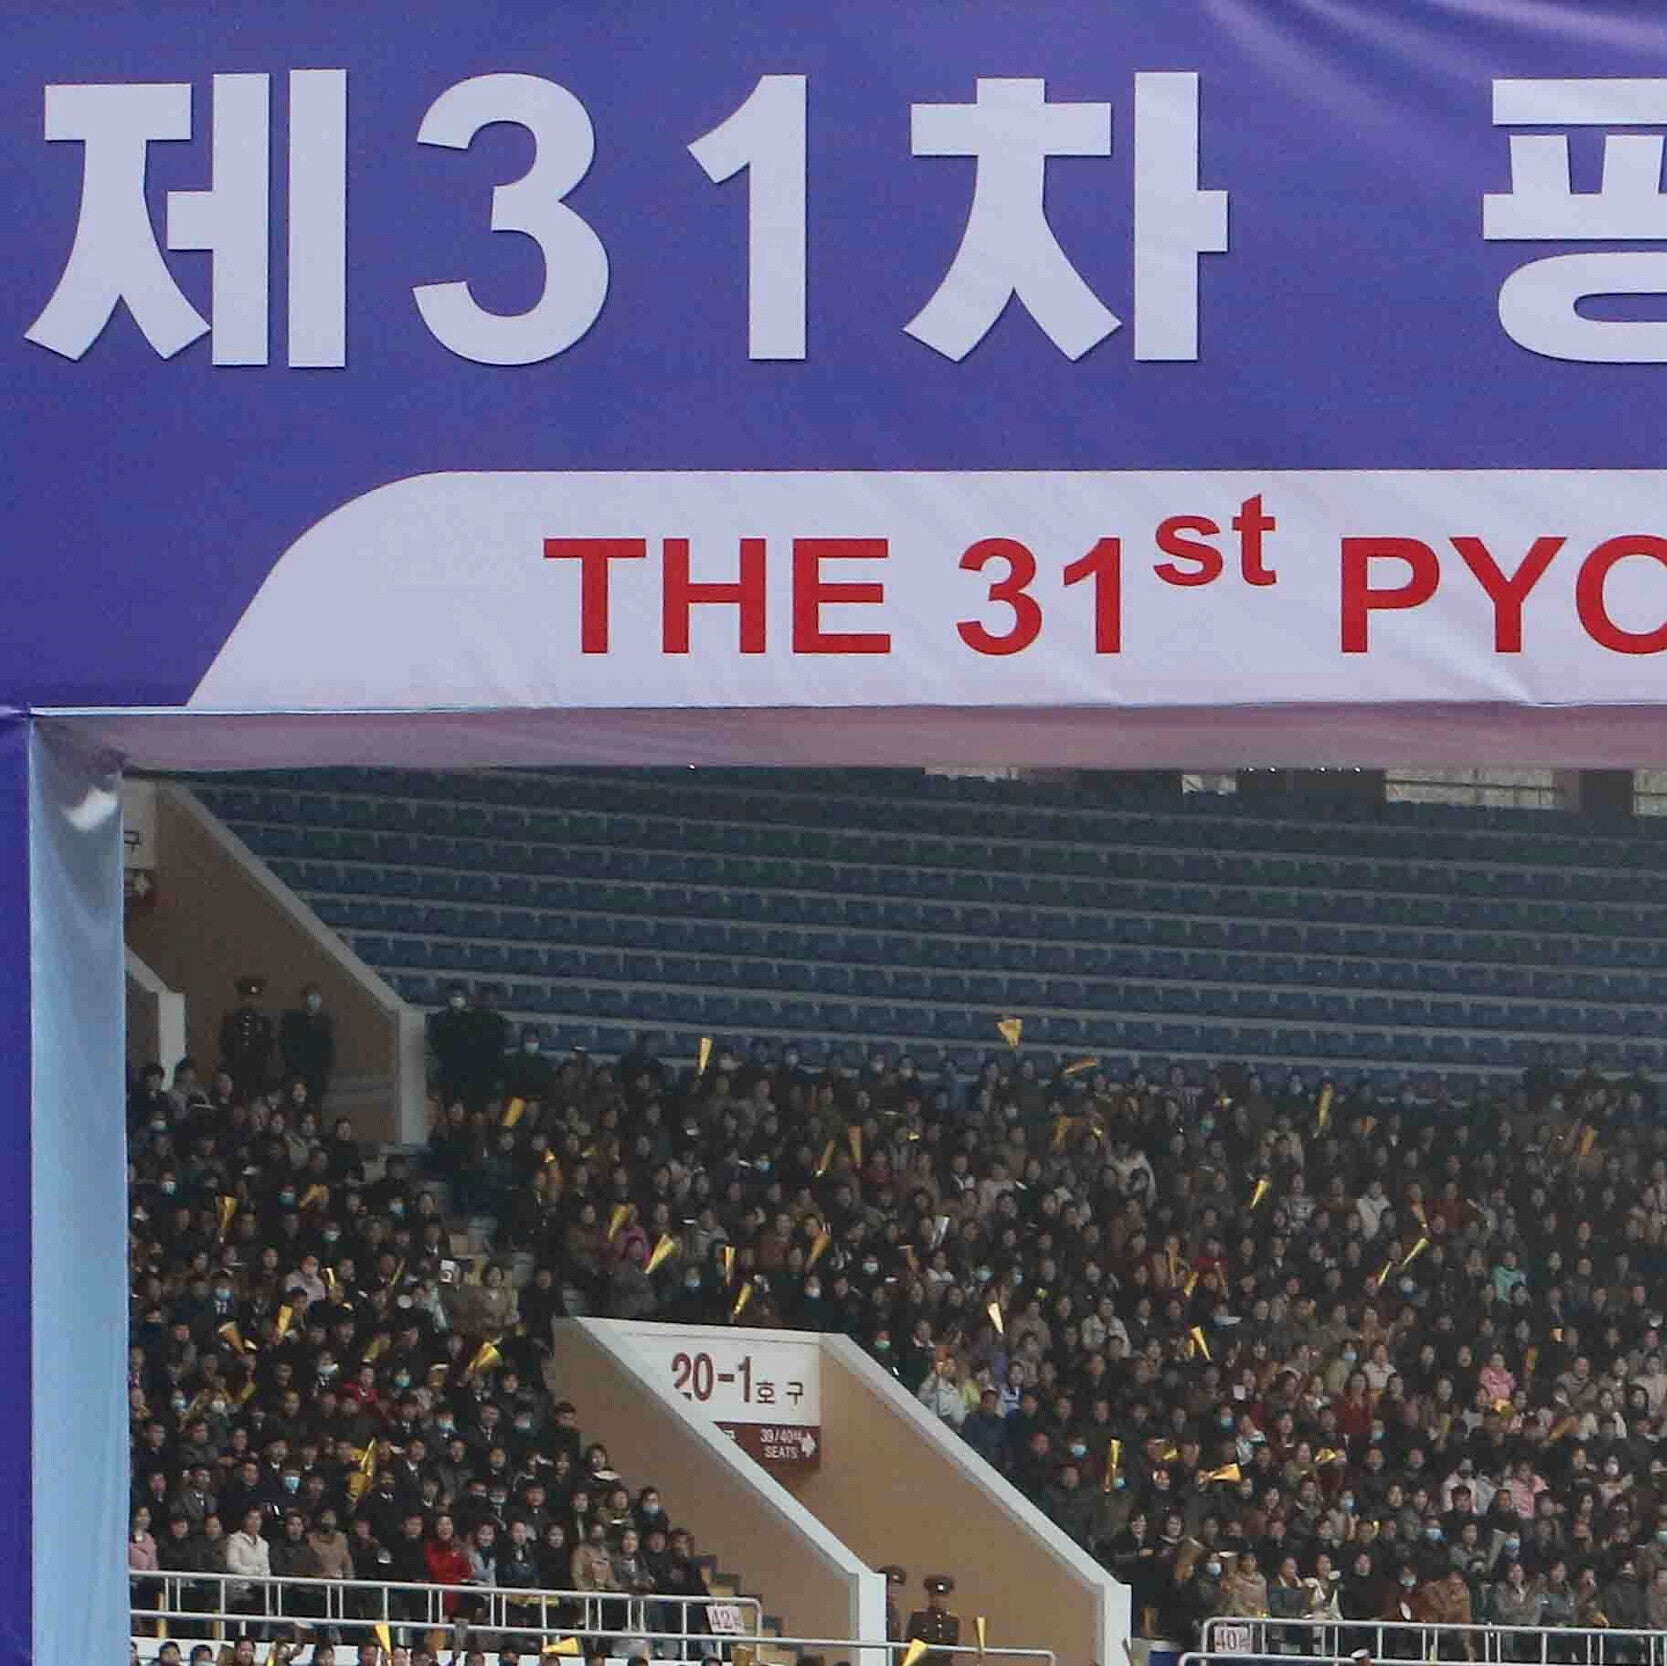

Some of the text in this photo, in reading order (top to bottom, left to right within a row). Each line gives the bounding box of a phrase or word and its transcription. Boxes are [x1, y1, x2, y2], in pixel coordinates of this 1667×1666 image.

[543, 537, 893, 656] THE
[957, 494, 1275, 658] 31st
[671, 1352, 751, 1403] 20-1
